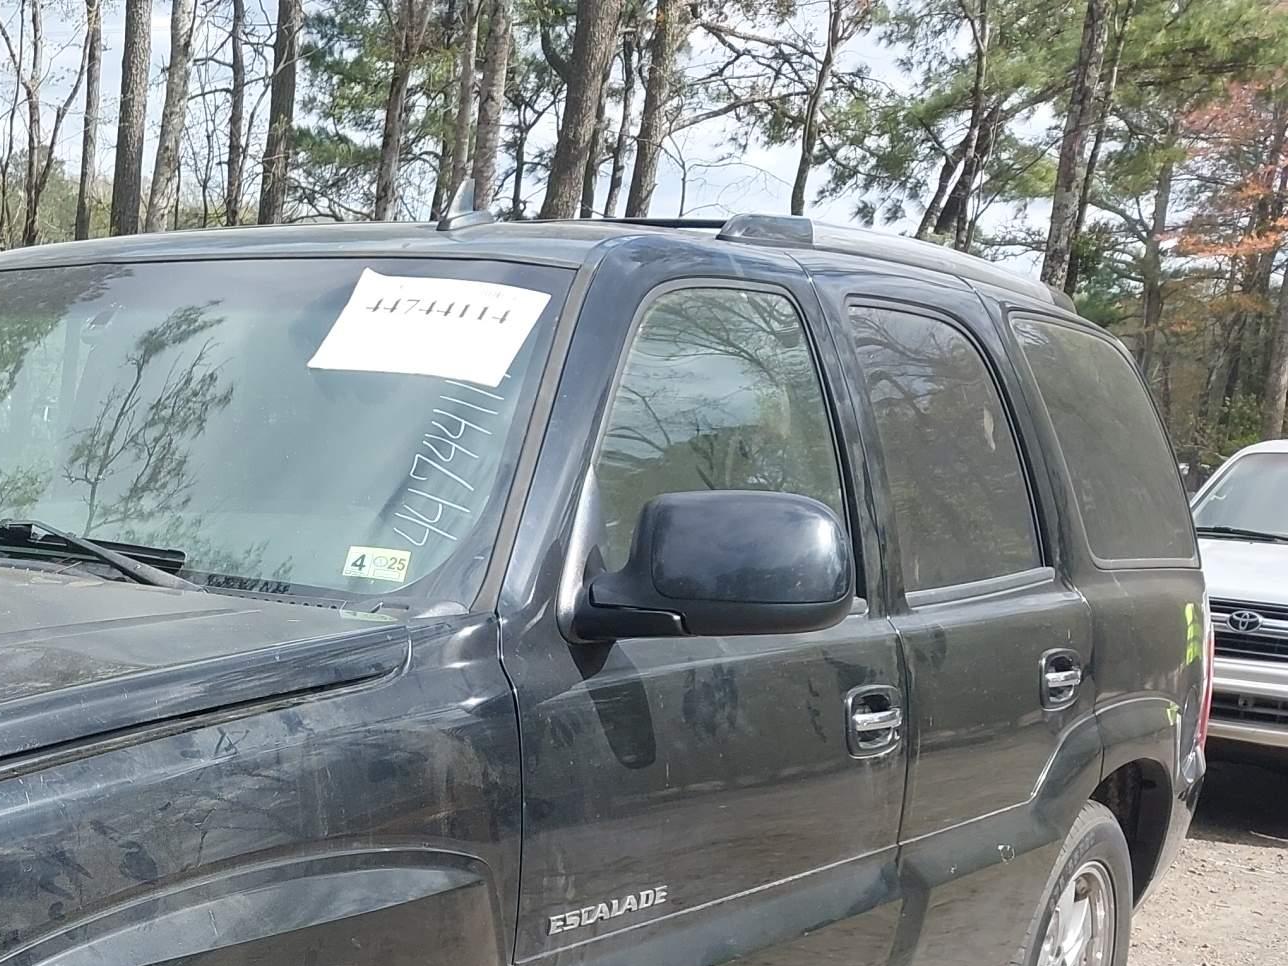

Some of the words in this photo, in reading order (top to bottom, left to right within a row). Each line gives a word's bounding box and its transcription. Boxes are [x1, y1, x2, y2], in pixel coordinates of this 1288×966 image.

[392, 374, 511, 547] 4474411
[350, 553, 367, 571] 4
[387, 556, 407, 572] 25
[548, 885, 669, 936] ESCALADE
